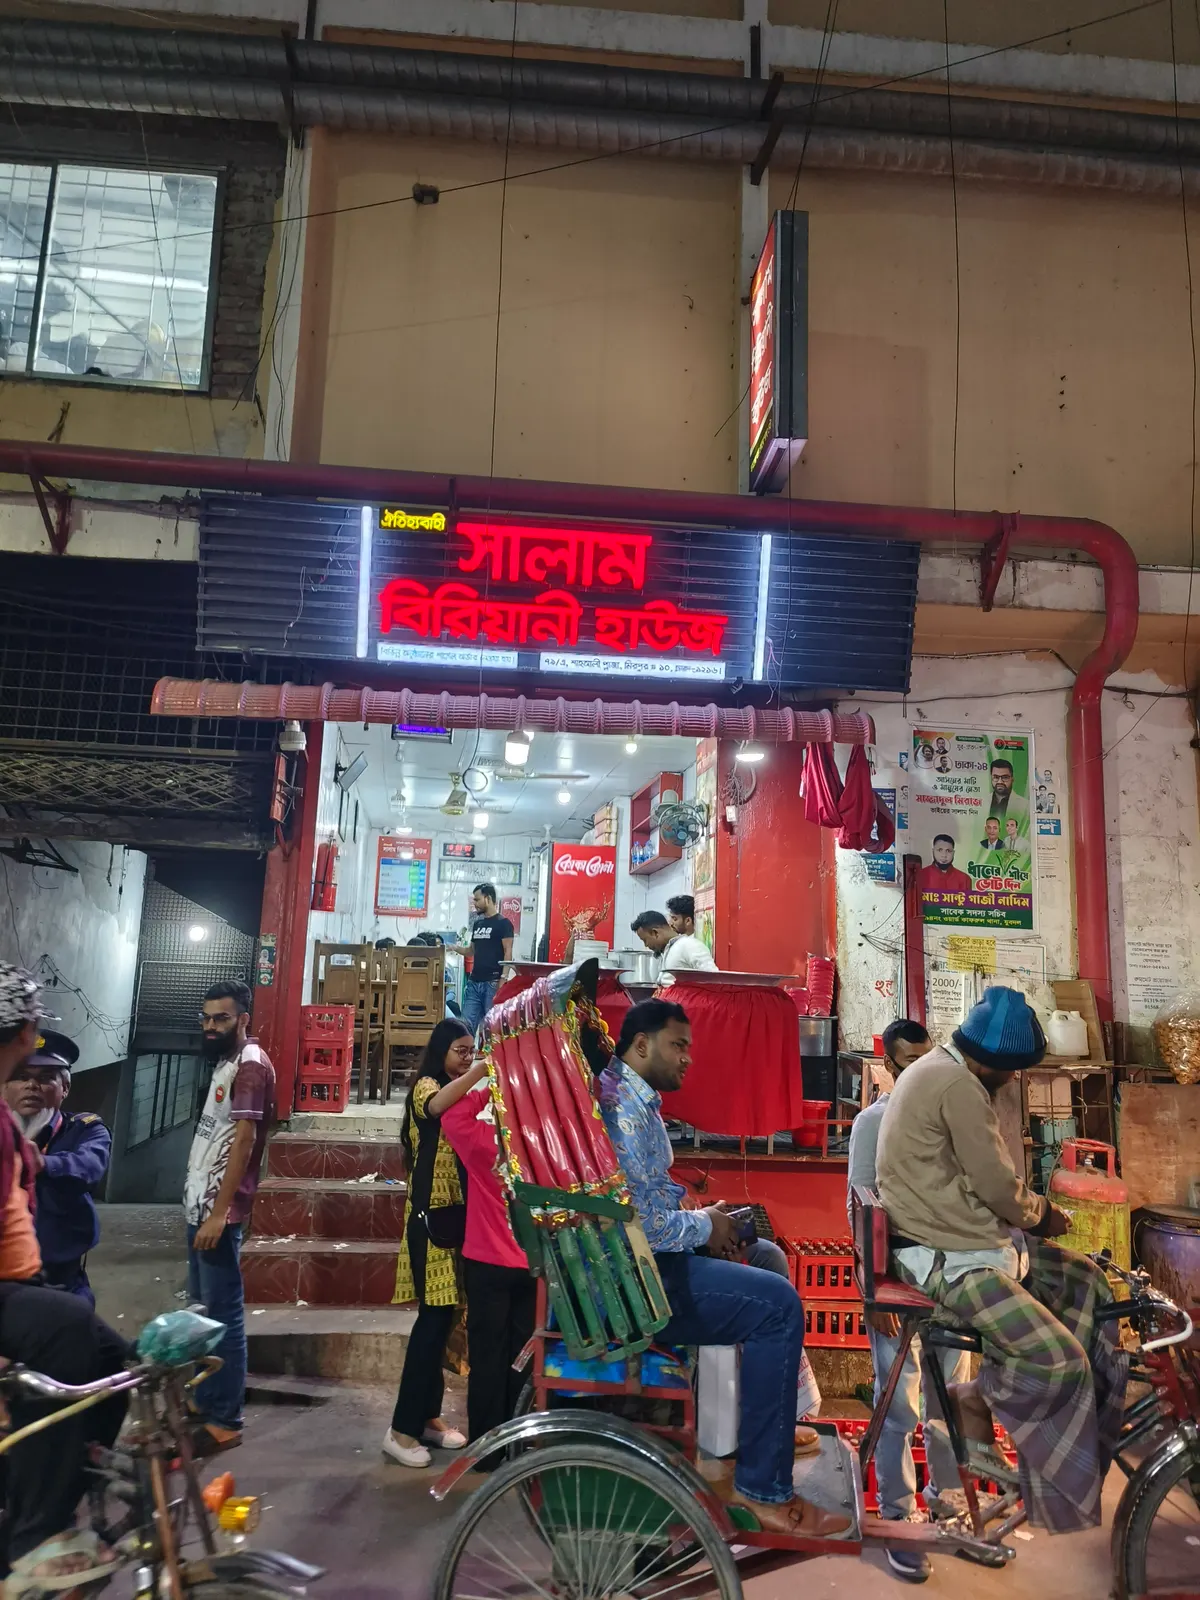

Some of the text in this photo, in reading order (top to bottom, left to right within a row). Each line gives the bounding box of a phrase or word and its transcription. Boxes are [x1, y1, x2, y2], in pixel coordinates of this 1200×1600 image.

[381, 509, 446, 531] ঐতিহ্যবাহী
[456, 522, 652, 589] সালাম
[378, 579, 728, 657] বিরিয়ানী হাউজ
[955, 760, 988, 771] ঢাকা-১৪
[967, 861, 1001, 879] ধানের
[975, 876, 1021, 891] ভোট দিন
[968, 892, 996, 905] গাজী
[997, 892, 1030, 908] নাদিম
[940, 907, 964, 916] সাবেক
[932, 977, 962, 990] 2000/-
